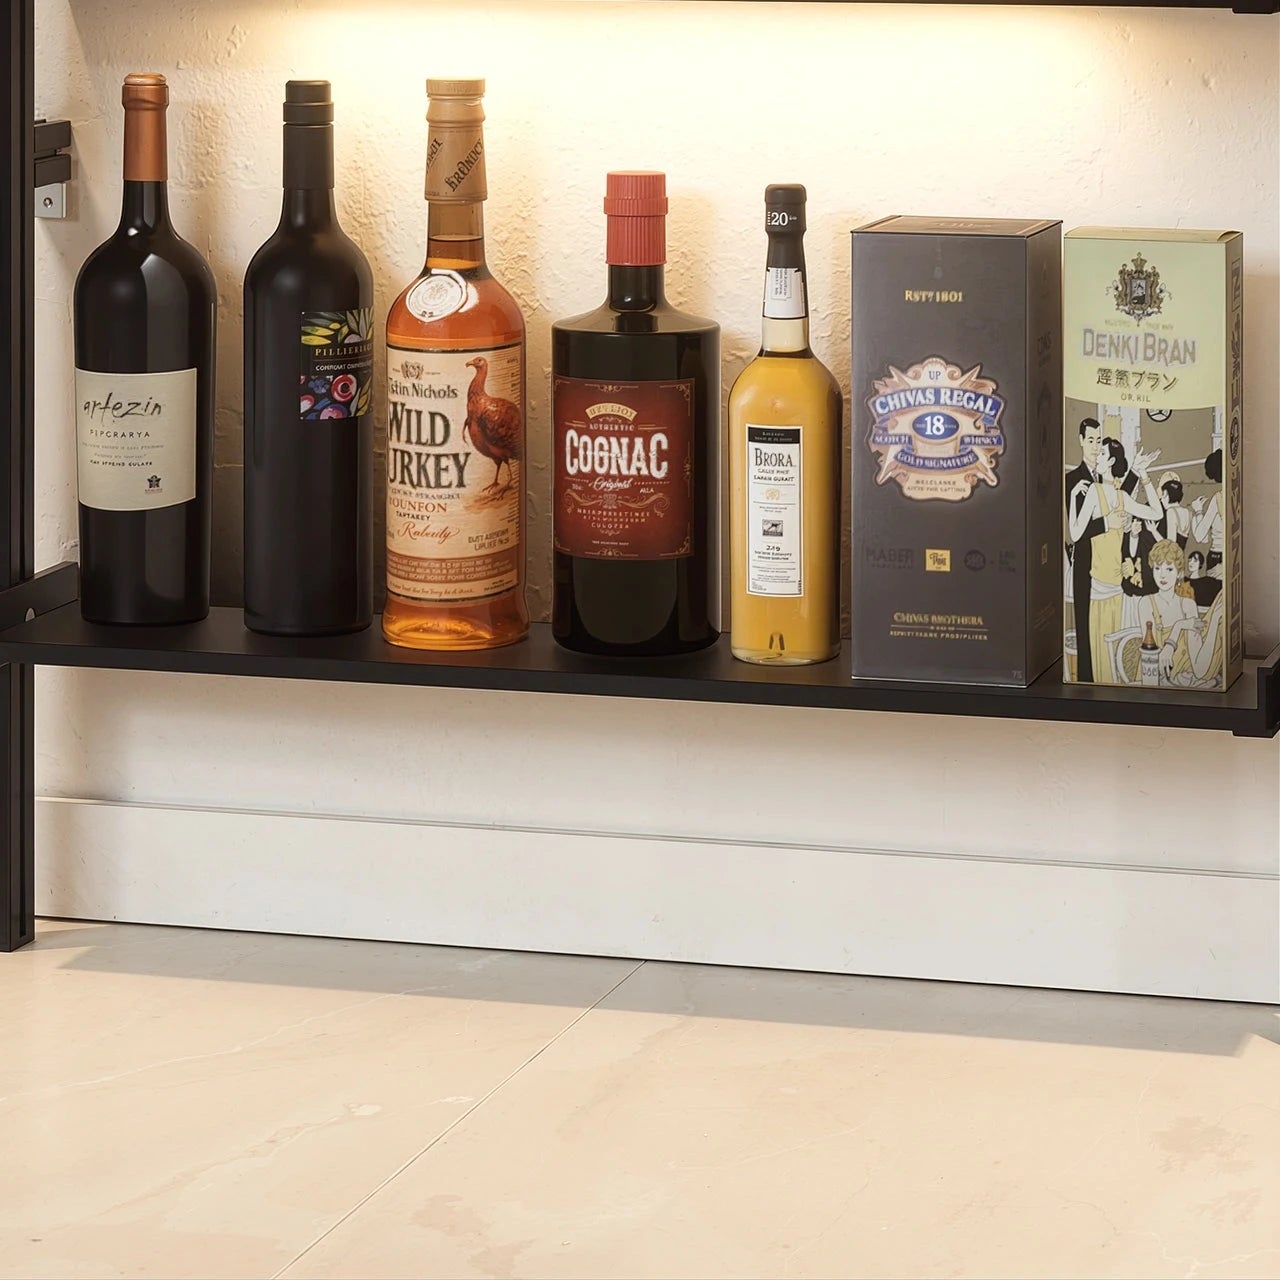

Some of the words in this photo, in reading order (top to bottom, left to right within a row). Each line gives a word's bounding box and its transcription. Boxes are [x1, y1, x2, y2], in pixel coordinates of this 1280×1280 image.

[771, 212, 789, 226] 20
[1082, 328, 1139, 366] DENKI
[1142, 332, 1197, 367] BRAN
[928, 370, 942, 381] UP
[84, 392, 162, 423] artezin
[875, 388, 937, 416] CHIVAS
[940, 388, 996, 417] REGAL
[389, 400, 451, 448] WILD
[924, 415, 946, 436] 18
[565, 429, 669, 479] COGNAC
[754, 447, 793, 468] BRORA
